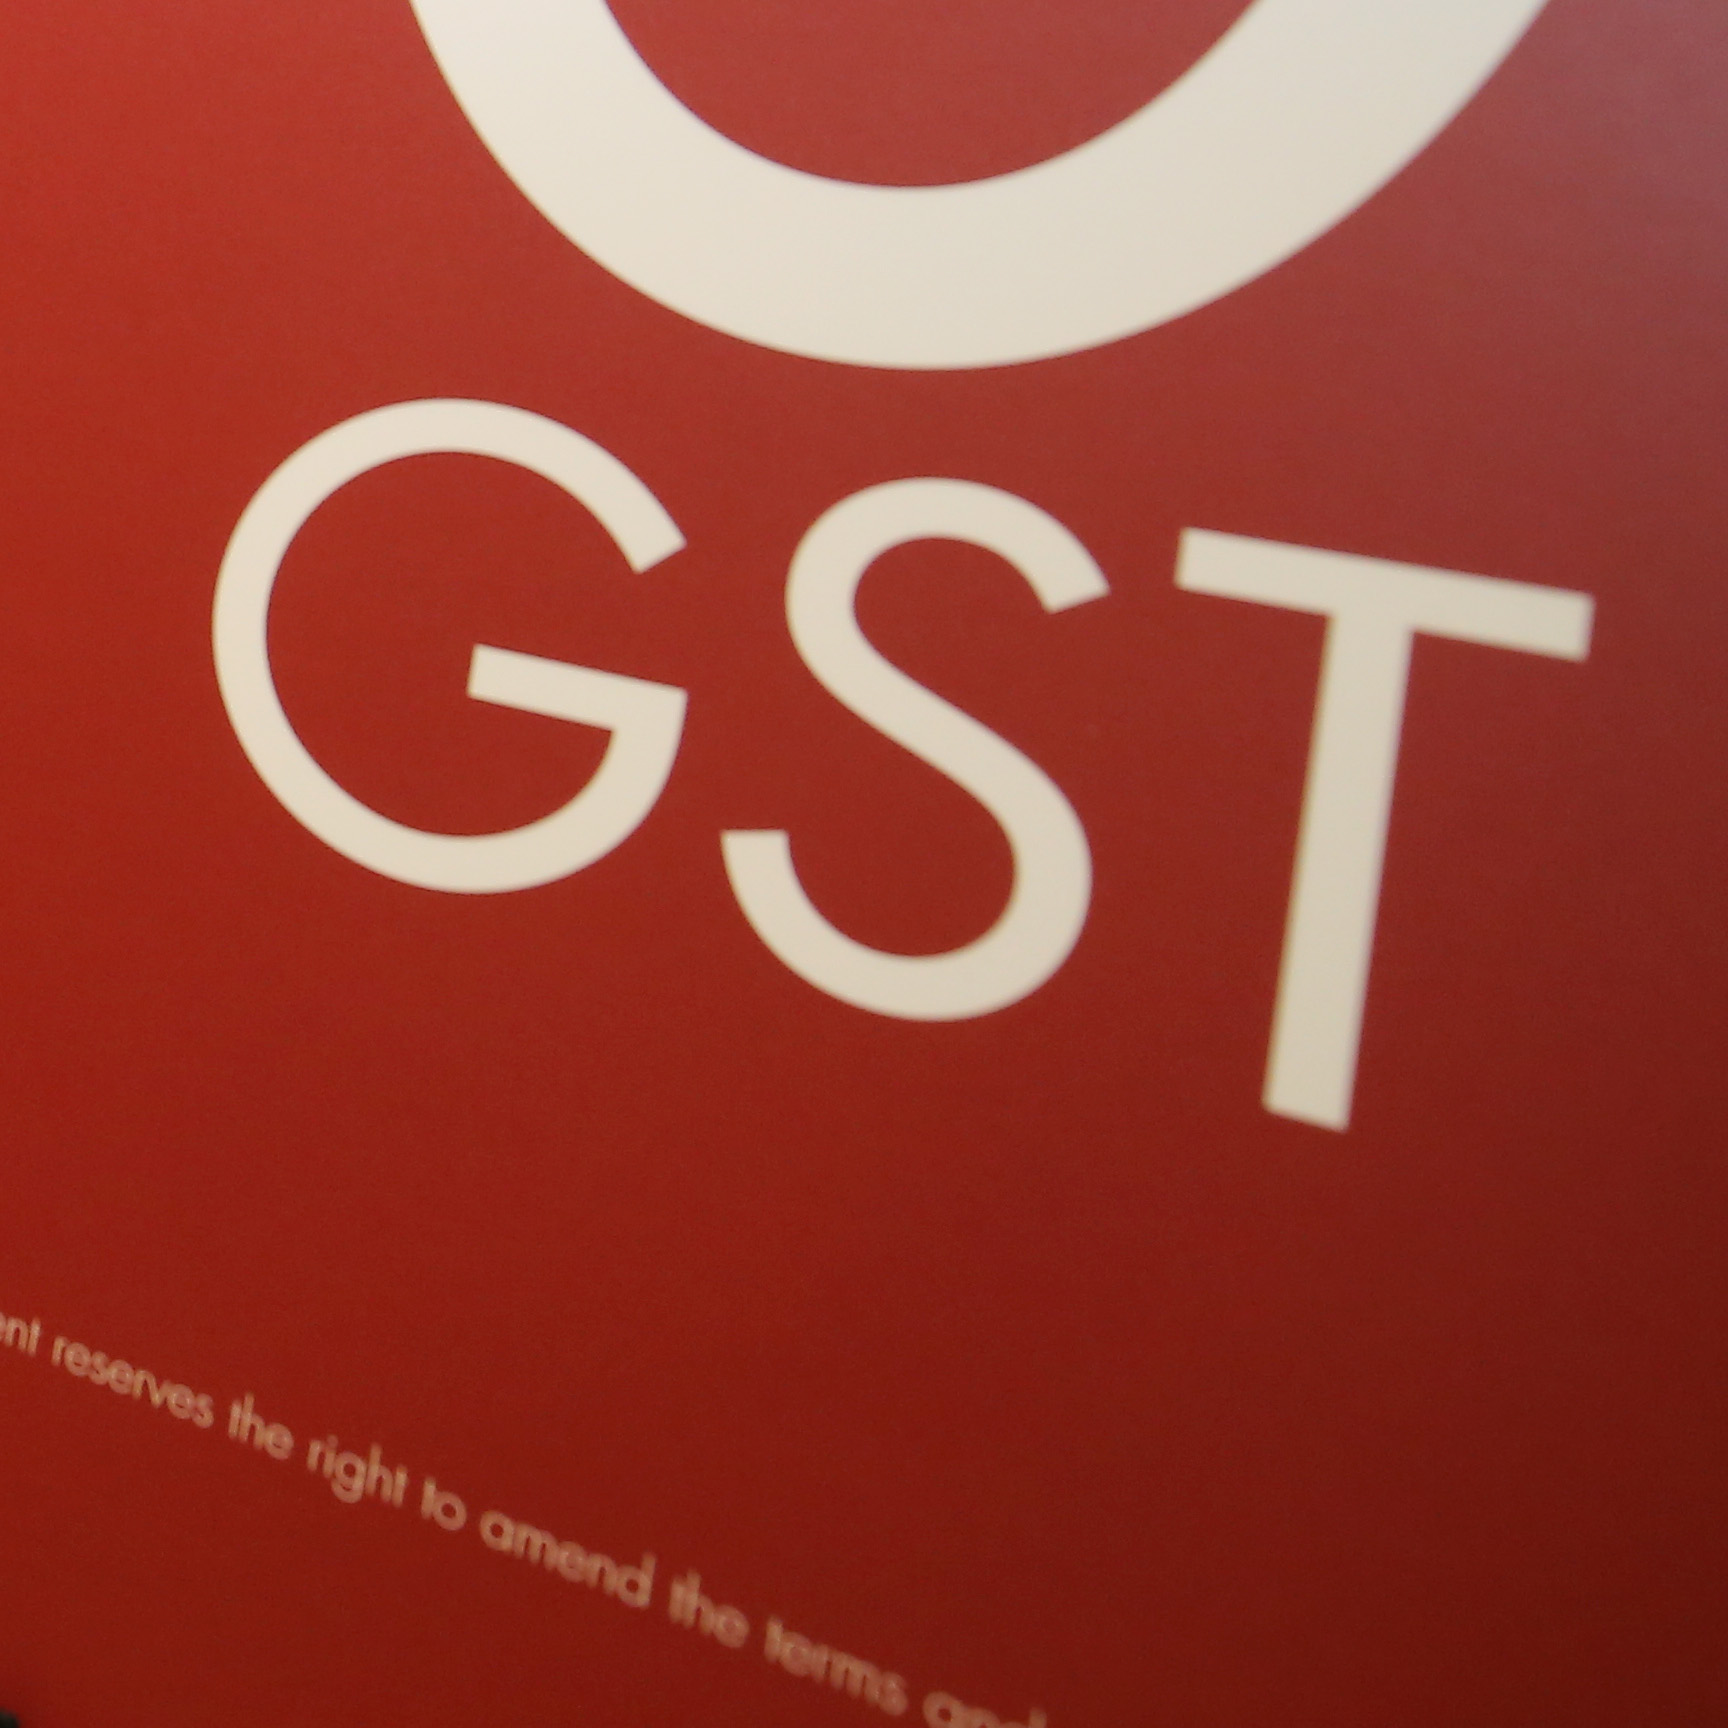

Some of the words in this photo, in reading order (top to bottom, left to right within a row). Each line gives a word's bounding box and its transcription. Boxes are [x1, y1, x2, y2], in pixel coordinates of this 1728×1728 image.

[214, 400, 1590, 1126] GST
[51, 1335, 214, 1428] reserves
[229, 1392, 294, 1459] the
[307, 1435, 409, 1505] right
[421, 1478, 467, 1531] to
[479, 1509, 656, 1608] amend
[765, 1617, 906, 1714] terms
